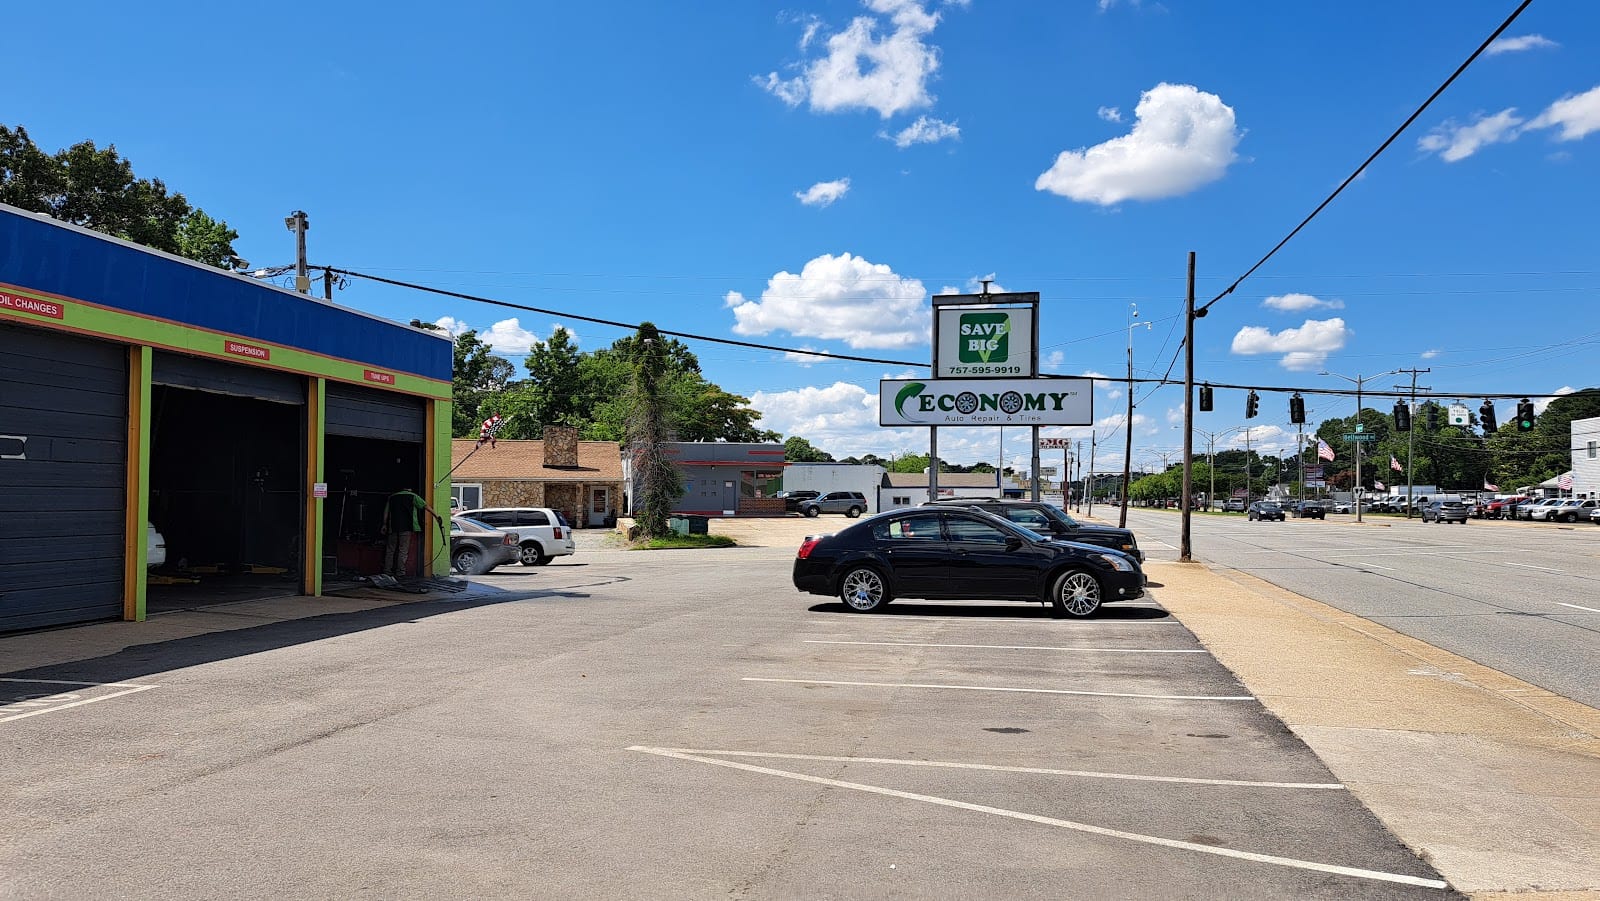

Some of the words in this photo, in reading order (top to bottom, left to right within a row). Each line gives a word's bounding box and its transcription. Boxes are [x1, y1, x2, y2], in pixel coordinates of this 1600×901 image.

[0, 294, 13, 306] OIL
[15, 298, 58, 315] CHANGES
[960, 323, 1006, 336] SAVE
[230, 343, 265, 358] SUSPENSION
[968, 339, 999, 352] BIG
[949, 366, 1021, 374] 757-595-9919
[918, 391, 1069, 414] ECONOMY
[972, 415, 1000, 424] Repair
